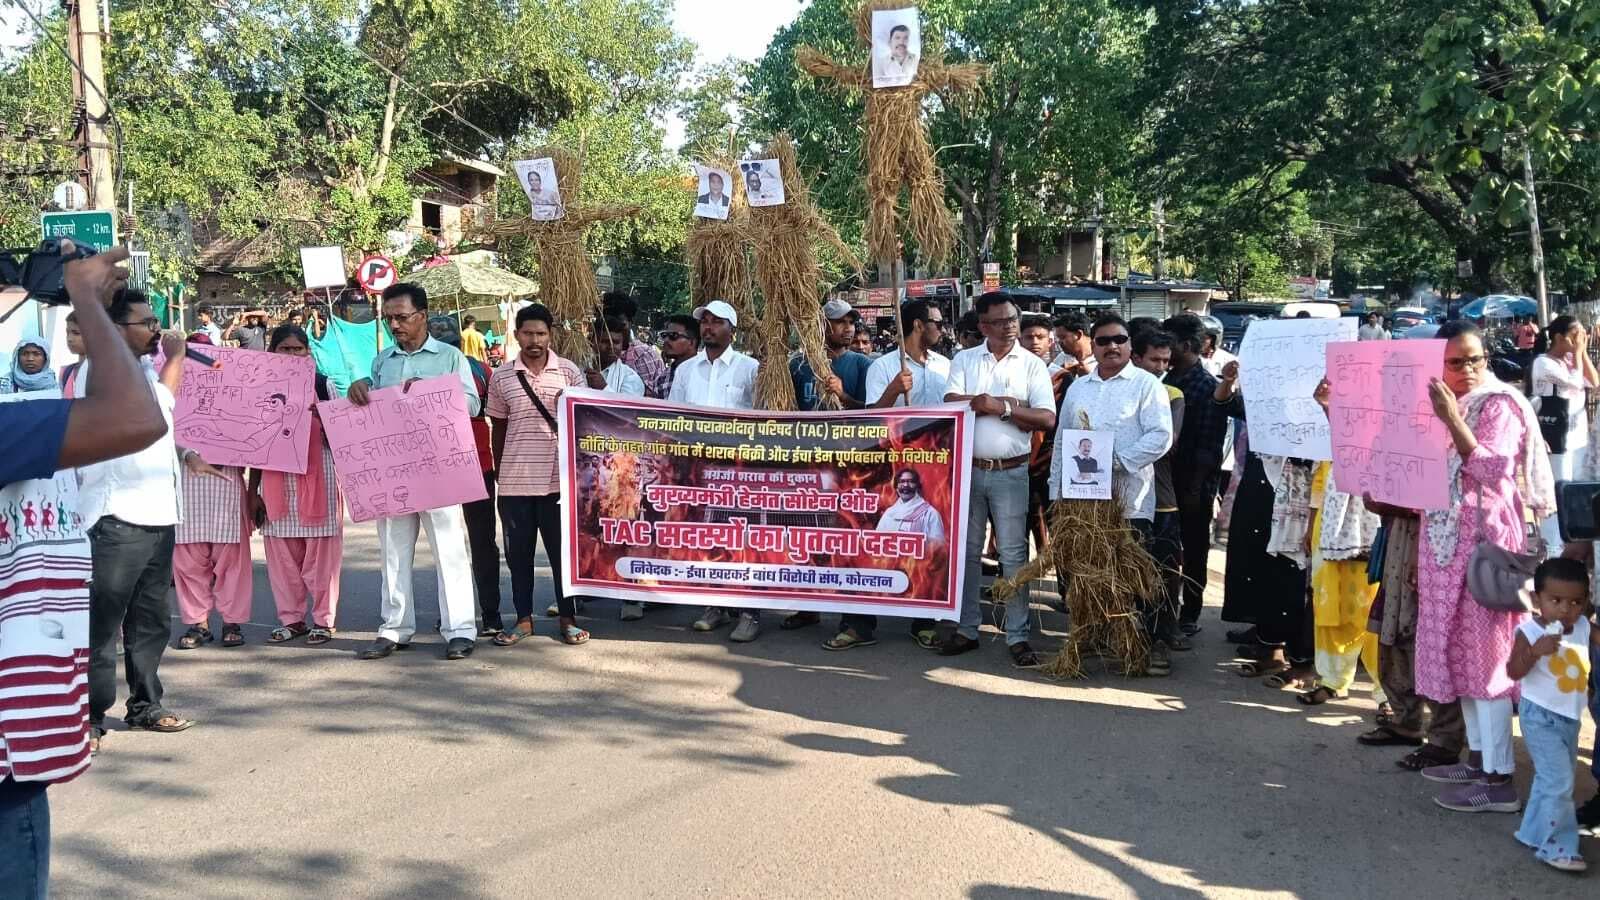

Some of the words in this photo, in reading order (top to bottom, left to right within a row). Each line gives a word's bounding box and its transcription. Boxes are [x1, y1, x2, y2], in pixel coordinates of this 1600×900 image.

[92, 223, 99, 234] 12
[637, 416, 693, 432] जनजातीय
[695, 419, 755, 440] परामर्शदातृ
[758, 420, 791, 437] परिषद
[795, 423, 829, 440] (TAC)
[831, 424, 855, 440] द्वारा
[858, 426, 889, 439] शराब
[579, 436, 605, 452] नीति
[607, 438, 619, 452] के
[648, 441, 667, 455] गांव
[669, 441, 689, 457] गांव
[690, 442, 703, 458] में
[705, 447, 735, 460] शराब
[738, 444, 765, 462] बिक्री
[767, 446, 790, 461] और
[792, 447, 812, 463] ईचा
[815, 446, 833, 463] डैम
[835, 447, 886, 467] पूर्णबहाल
[887, 447, 899, 463] के
[901, 447, 934, 464] विरोध
[936, 448, 950, 465] में
[787, 472, 817, 486] दुकान
[646, 484, 736, 511] मुख्यमंत्री
[737, 485, 782, 510] हेमंत
[784, 488, 839, 512] सोरेन
[840, 488, 879, 514] और
[600, 518, 651, 546] TAC
[654, 517, 748, 550] सदस्यों
[749, 524, 786, 552] का
[788, 526, 861, 563] पुतला
[862, 530, 926, 560] दहन
[630, 560, 672, 576] निवेदक
[686, 565, 706, 579] ईचा
[709, 567, 750, 581] खरकई
[753, 567, 776, 582] बांध
[779, 568, 816, 584] विरोधी
[819, 569, 842, 586] संघ,
[845, 571, 893, 588] कोल्हान
